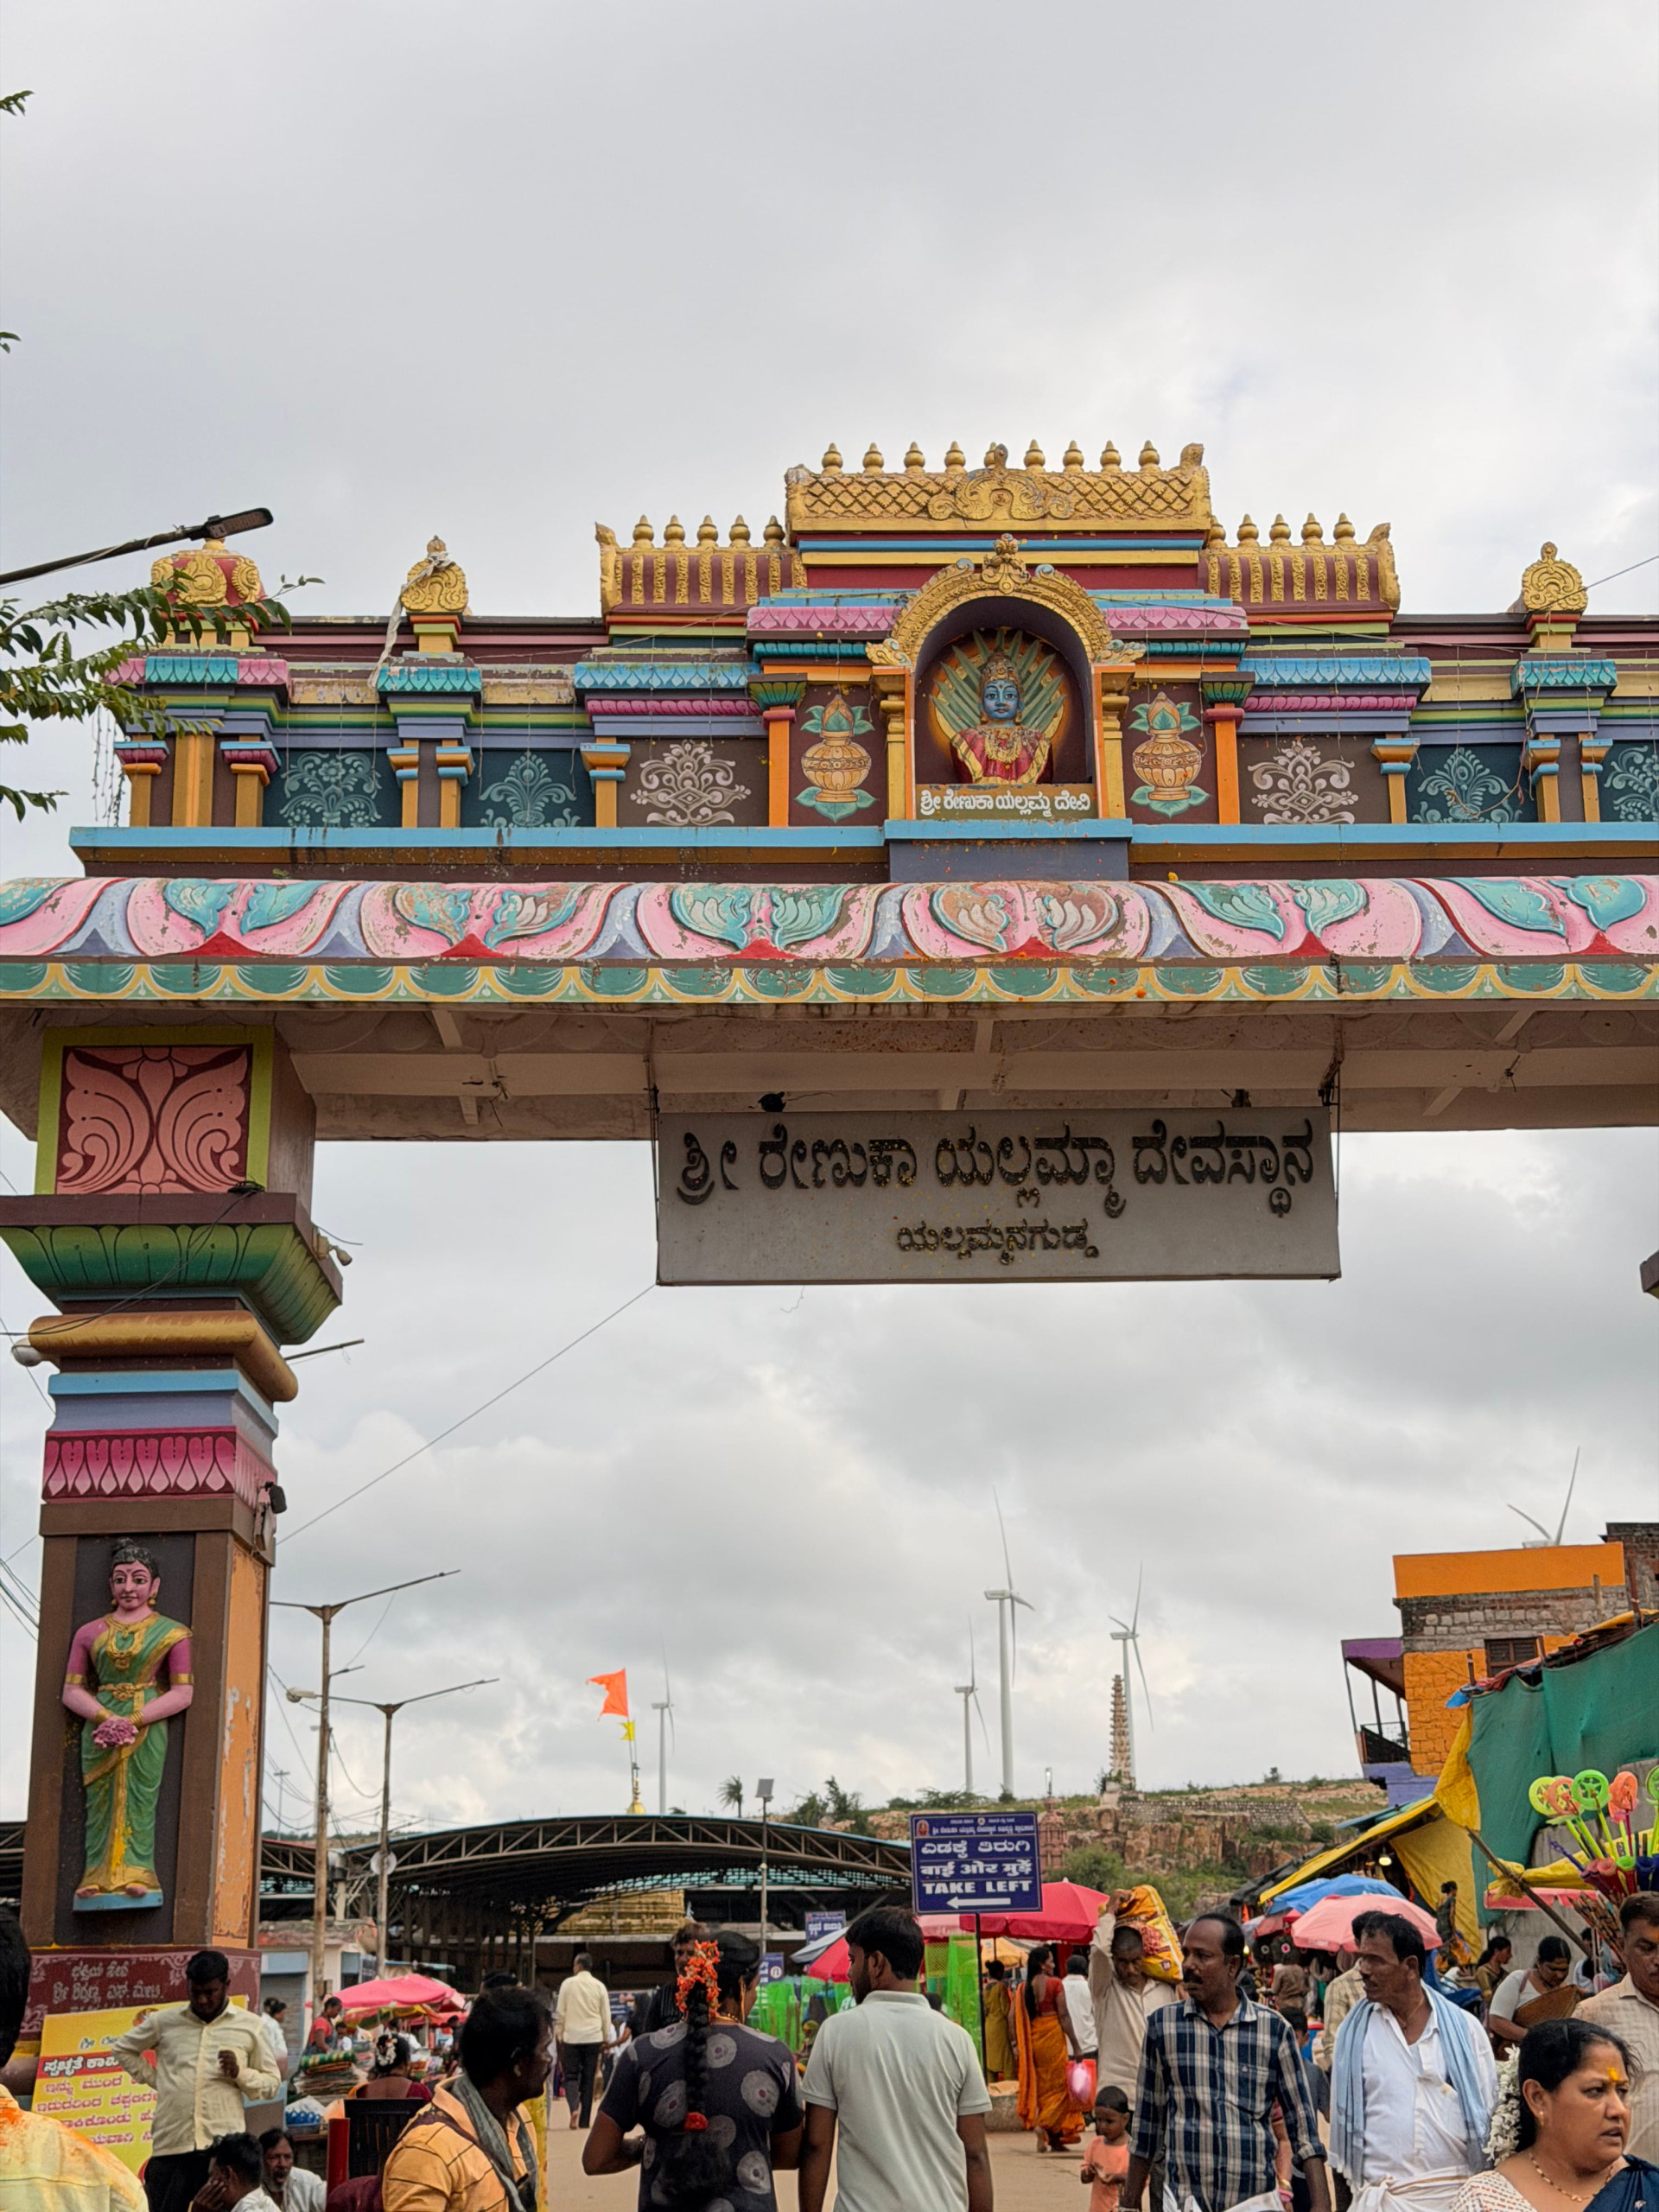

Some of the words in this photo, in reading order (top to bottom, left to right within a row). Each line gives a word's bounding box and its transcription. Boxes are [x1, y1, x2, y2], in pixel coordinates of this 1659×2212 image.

[920, 789, 941, 816] ಶ್ರೀ
[943, 788, 994, 810] ರೇಣುಕಾ
[995, 789, 1052, 817] ಯಲ್ಲಮ್ಮ
[1054, 789, 1090, 810] ದೇವಿ
[677, 1132, 740, 1205] ಶ್ರೀ
[758, 1122, 917, 1190] ರೇಣುಕಾ
[1131, 1117, 1313, 1218] ದೇವಸ್ಥಾನ
[897, 1217, 1099, 1266] ಯಲ್ಲಮ್ಮನಗುಡ್ಡ
[921, 1840, 968, 1859] ಎಡಕ್ಕೆ
[977, 1839, 1031, 1853] ತಿರುಗಿ
[960, 1860, 998, 1874] ओर
[922, 1881, 976, 1895] TAKE
[985, 1880, 1033, 1893] LEFT
